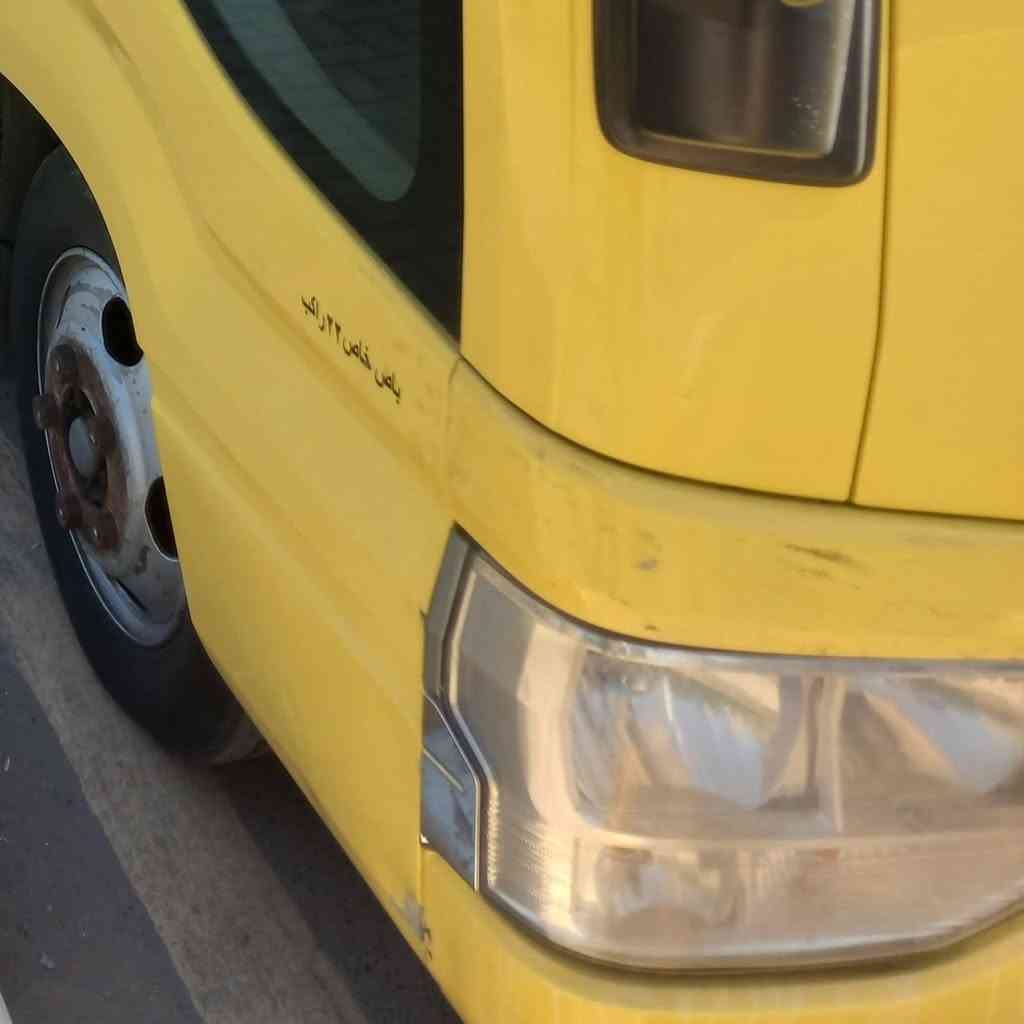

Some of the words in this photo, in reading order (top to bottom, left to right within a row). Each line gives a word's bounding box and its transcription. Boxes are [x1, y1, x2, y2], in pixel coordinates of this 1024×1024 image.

[301, 295, 326, 332] راكب
[342, 338, 372, 370] خاص
[374, 368, 401, 405] باص
